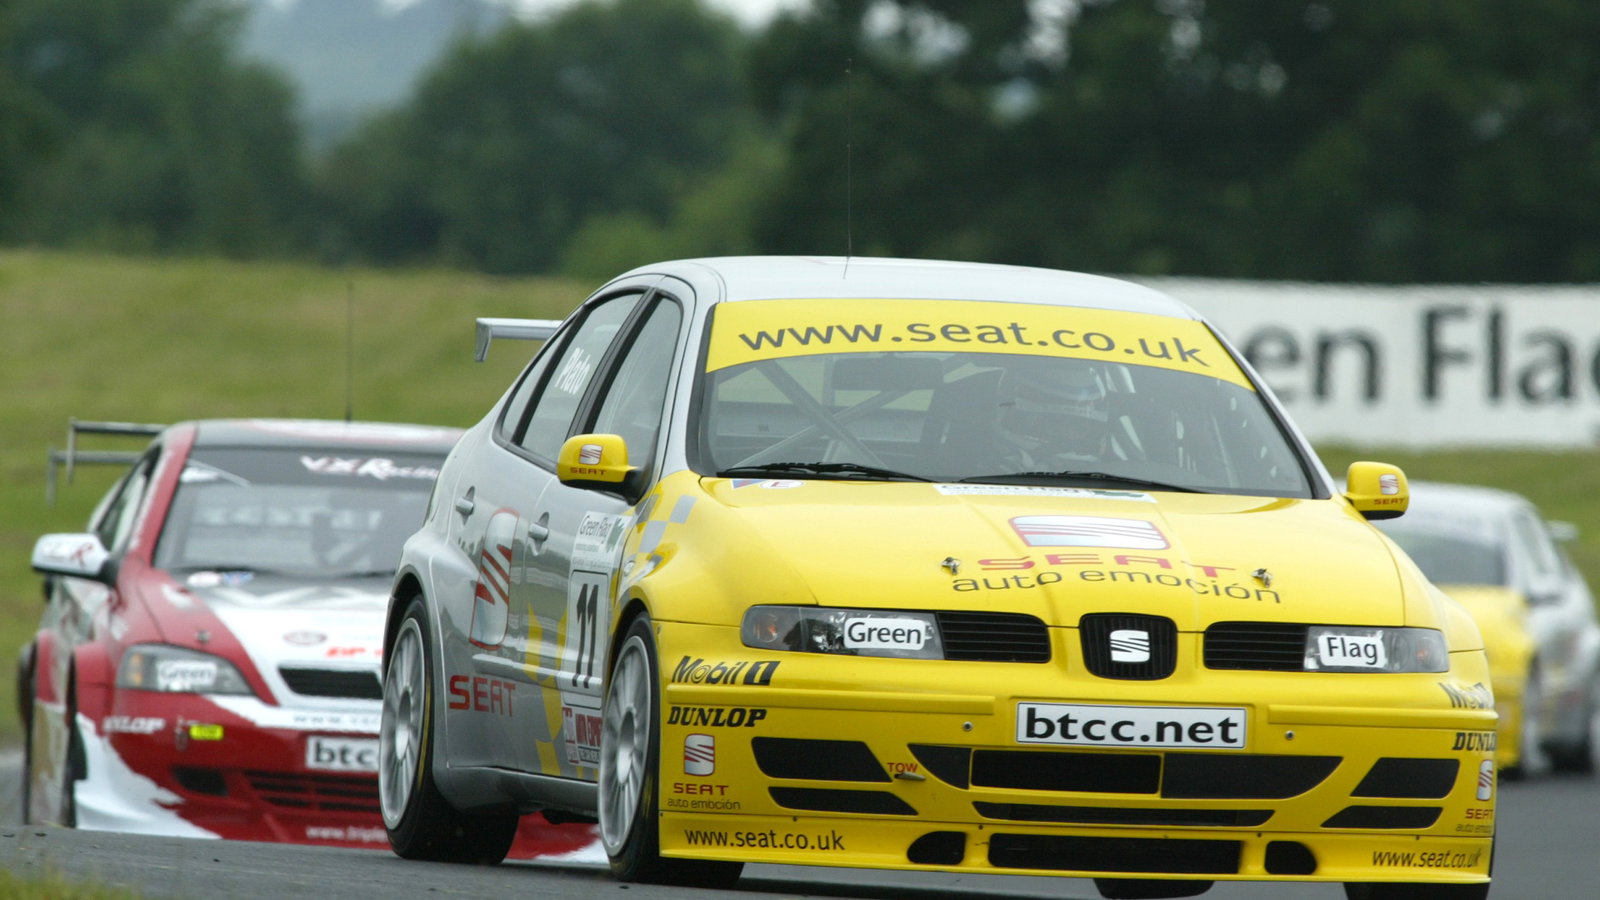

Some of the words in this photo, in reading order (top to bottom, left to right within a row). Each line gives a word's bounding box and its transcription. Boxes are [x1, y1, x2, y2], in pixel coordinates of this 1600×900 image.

[739, 320, 1210, 367] www.seat.co.uk
[570, 466, 608, 476] SEAT
[1374, 497, 1405, 505] SEAT
[579, 514, 600, 537] Green
[977, 553, 1236, 578] SEAT
[952, 571, 1063, 593] auto
[1079, 569, 1282, 604] emoción
[572, 583, 599, 688] 11
[847, 621, 921, 647] Green
[1326, 636, 1379, 666] Flag
[672, 655, 748, 685] Mobil
[449, 674, 516, 717] SEAT
[667, 706, 767, 727] DUNLOP
[1026, 707, 1238, 744] btcc.net
[314, 741, 380, 766] btc
[887, 762, 918, 774] TOW
[673, 782, 729, 796] SEAT
[667, 798, 689, 809] auto
[684, 829, 846, 851] www.seat.co.uk
[1372, 848, 1481, 868] www.seat.co.uk
